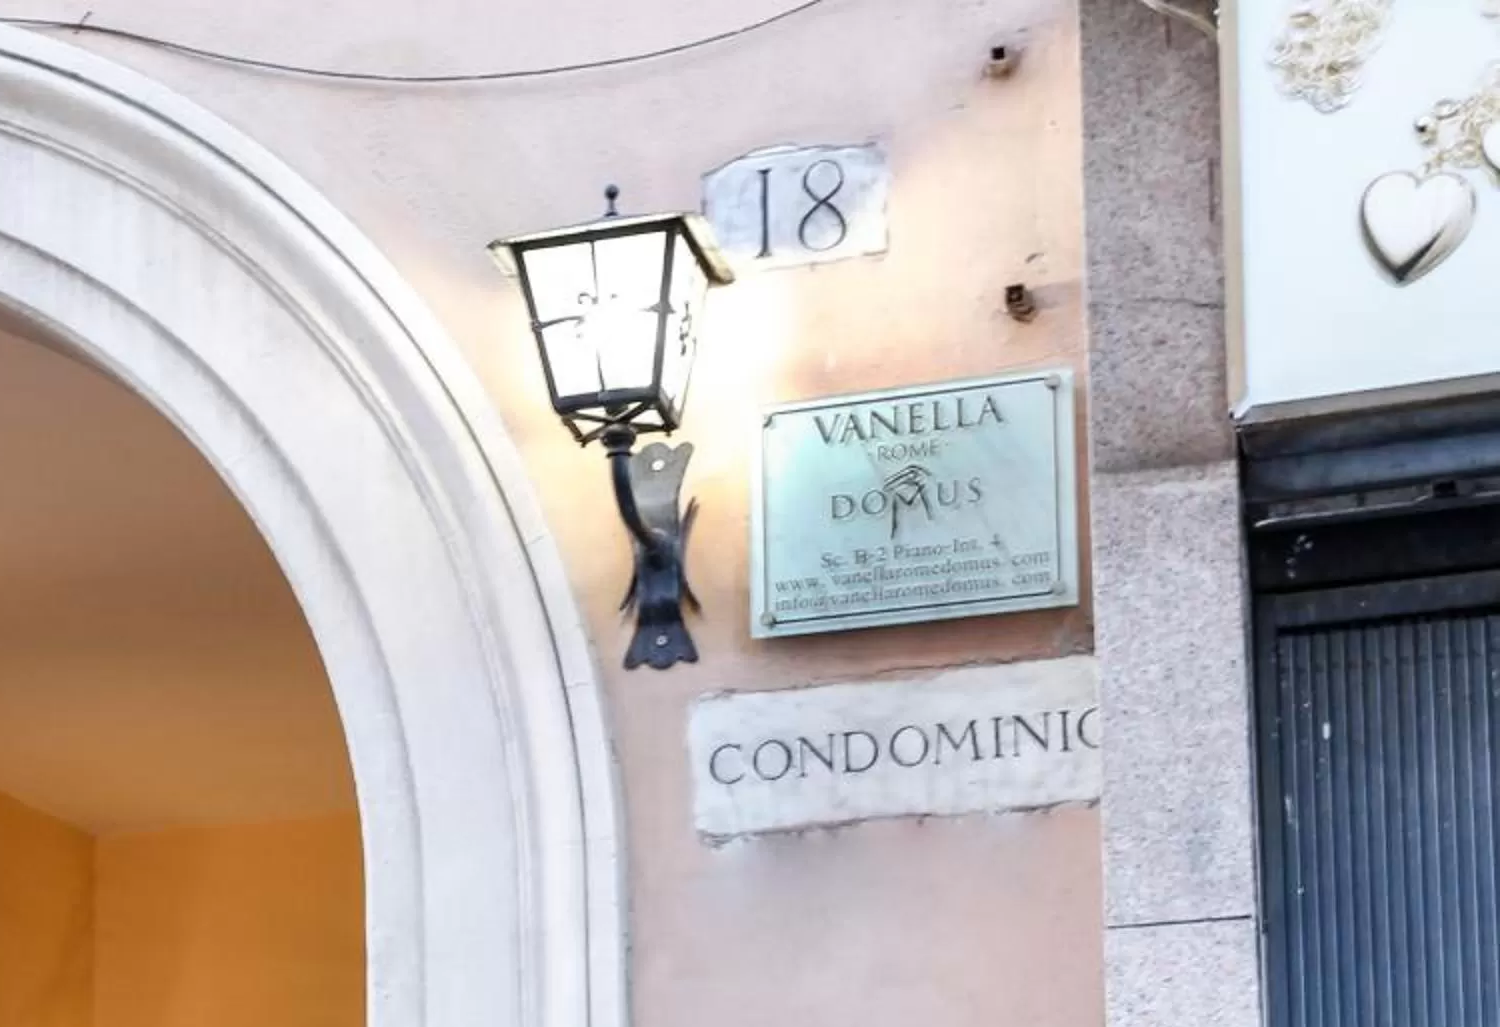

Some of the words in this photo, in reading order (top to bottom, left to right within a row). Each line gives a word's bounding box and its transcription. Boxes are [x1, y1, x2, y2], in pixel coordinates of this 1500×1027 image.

[755, 158, 847, 259] 18
[812, 394, 1005, 445] VANELLA
[830, 474, 983, 540] DOMUS
